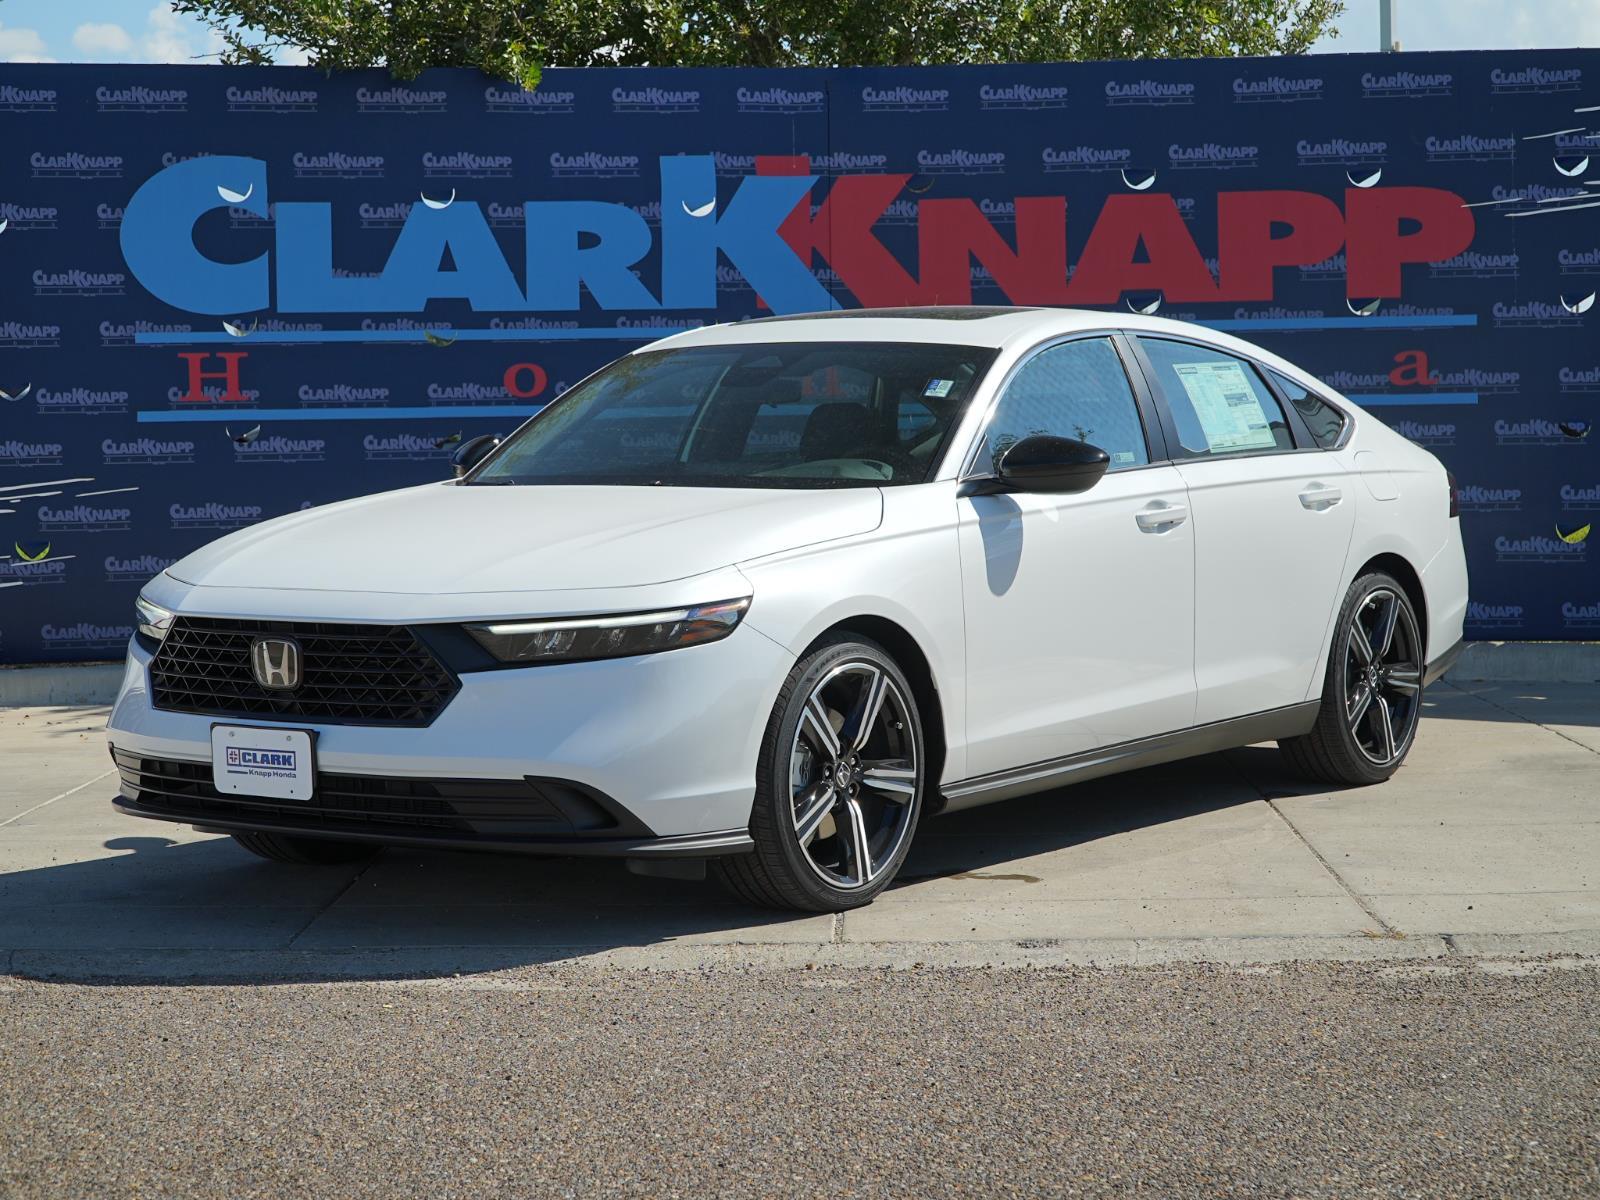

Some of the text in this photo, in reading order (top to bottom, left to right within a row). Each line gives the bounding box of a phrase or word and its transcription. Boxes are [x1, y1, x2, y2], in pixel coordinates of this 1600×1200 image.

[241, 751, 293, 767] CLARK
[249, 769, 297, 778] Knapp Honda
